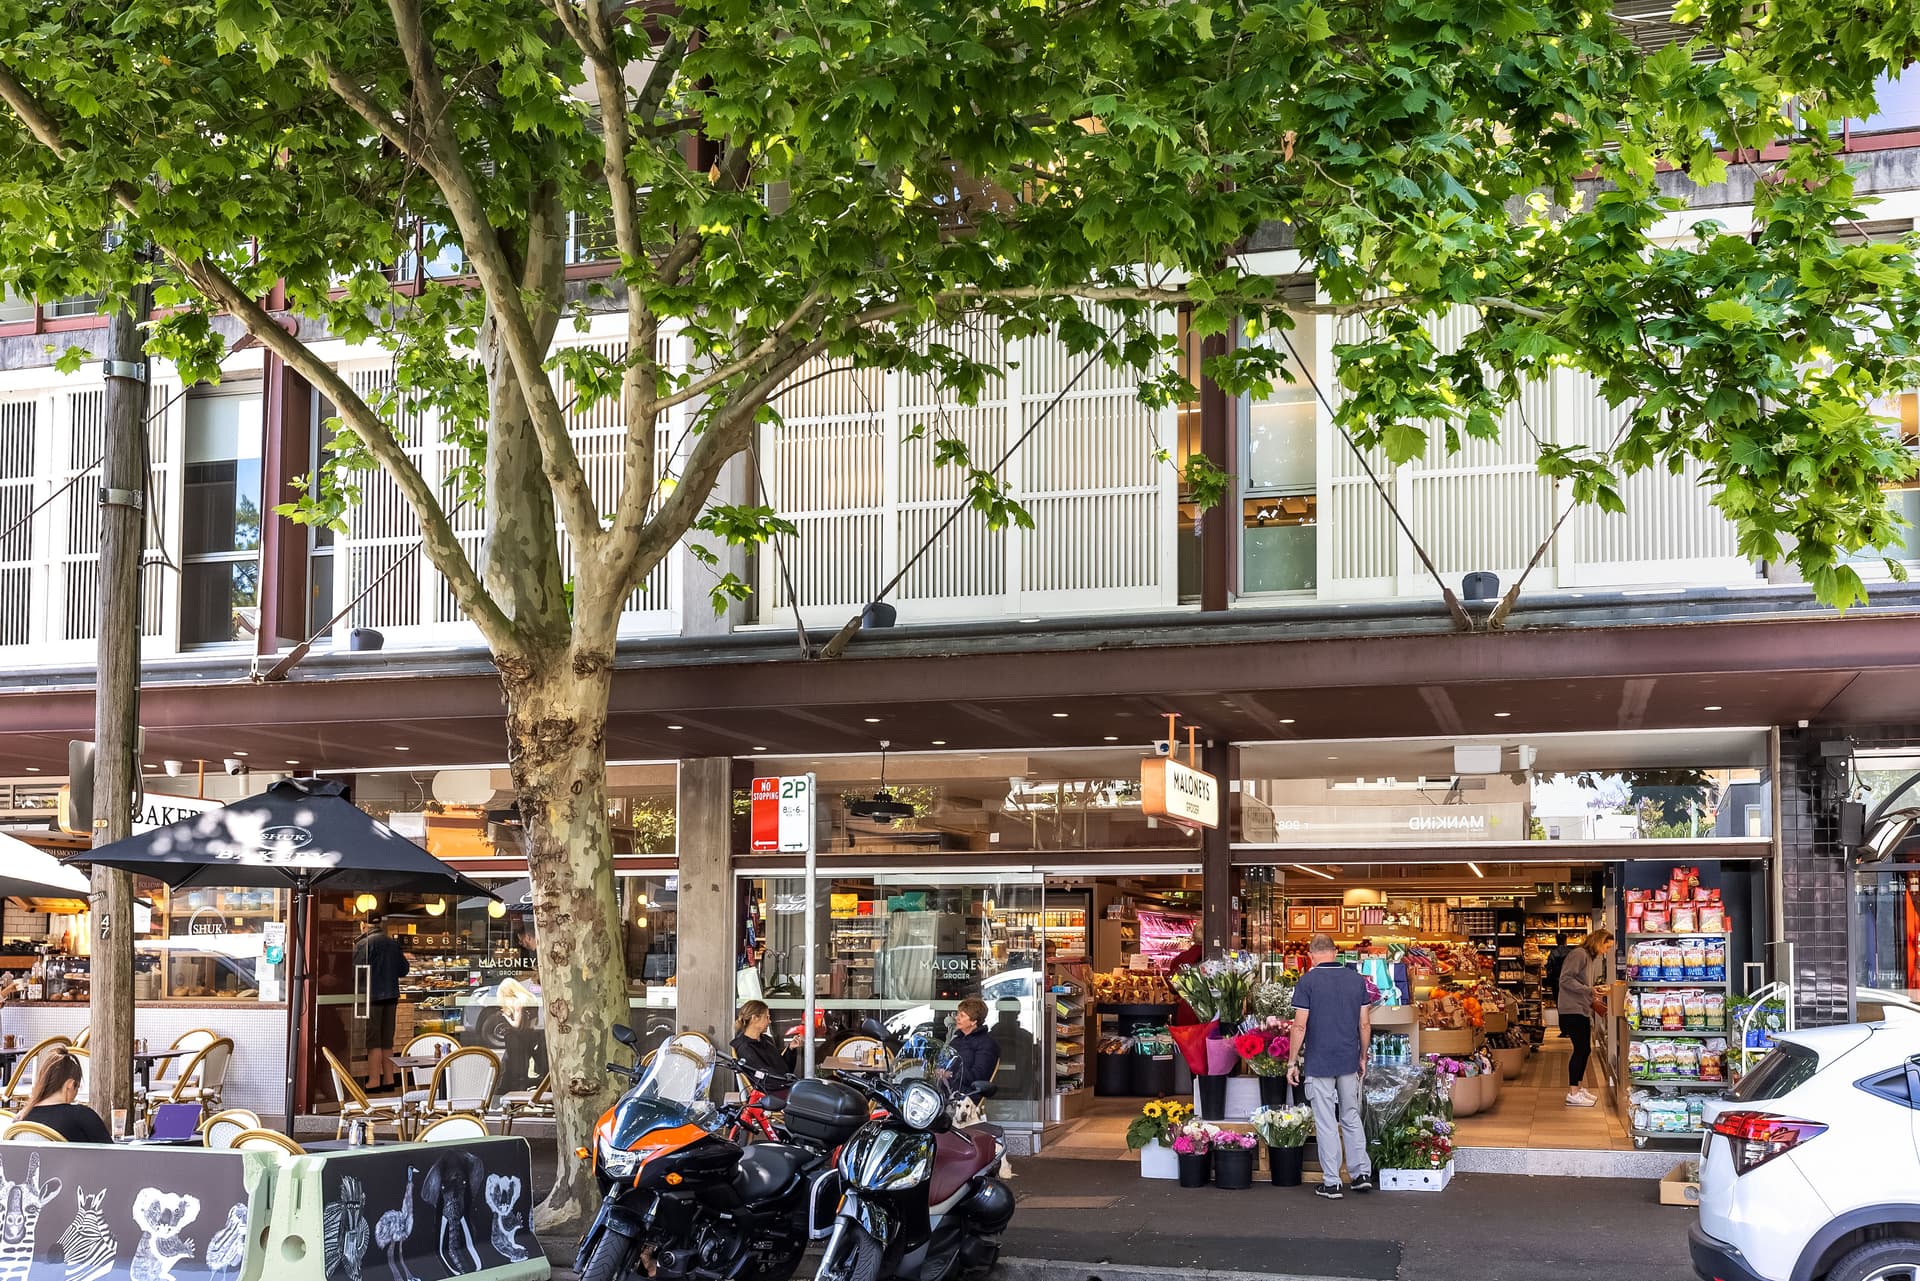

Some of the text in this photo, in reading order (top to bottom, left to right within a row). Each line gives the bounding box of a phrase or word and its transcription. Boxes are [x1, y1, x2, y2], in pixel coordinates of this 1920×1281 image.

[761, 781, 771, 791] NO
[782, 781, 806, 799] 2P
[1173, 769, 1210, 801] MALONEYS
[753, 792, 779, 800] STOPPING
[193, 923, 223, 934] SHUK
